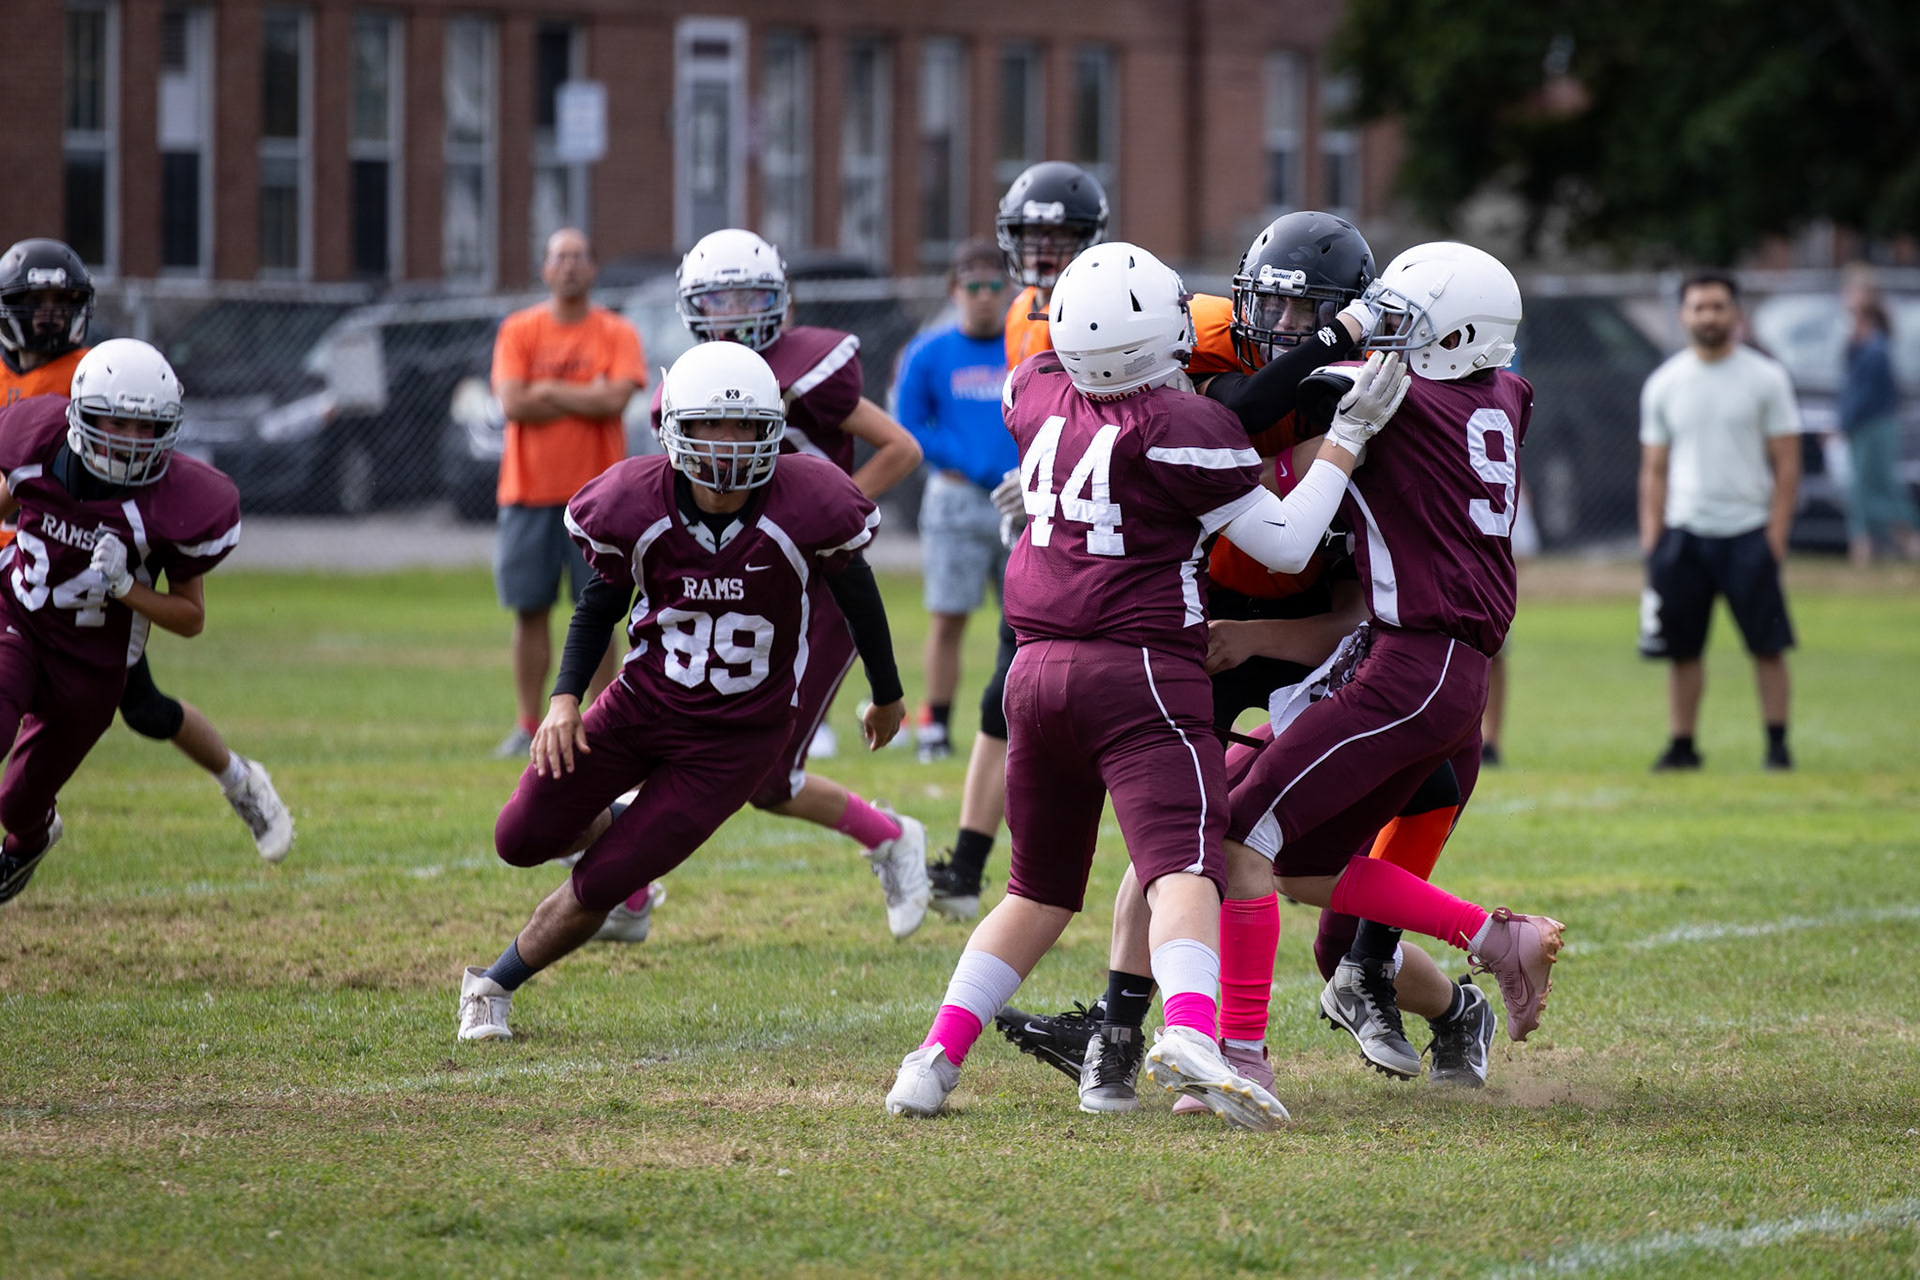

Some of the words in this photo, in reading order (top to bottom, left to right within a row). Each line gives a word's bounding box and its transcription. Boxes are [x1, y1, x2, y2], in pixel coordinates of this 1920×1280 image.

[1085, 383, 1153, 402] Riddell
[1020, 415, 1125, 556] 44
[1466, 408, 1517, 538] 9
[41, 512, 97, 552] RAMS
[10, 529, 108, 627] 34
[681, 576, 745, 600] RAMS
[657, 606, 775, 695] 89
